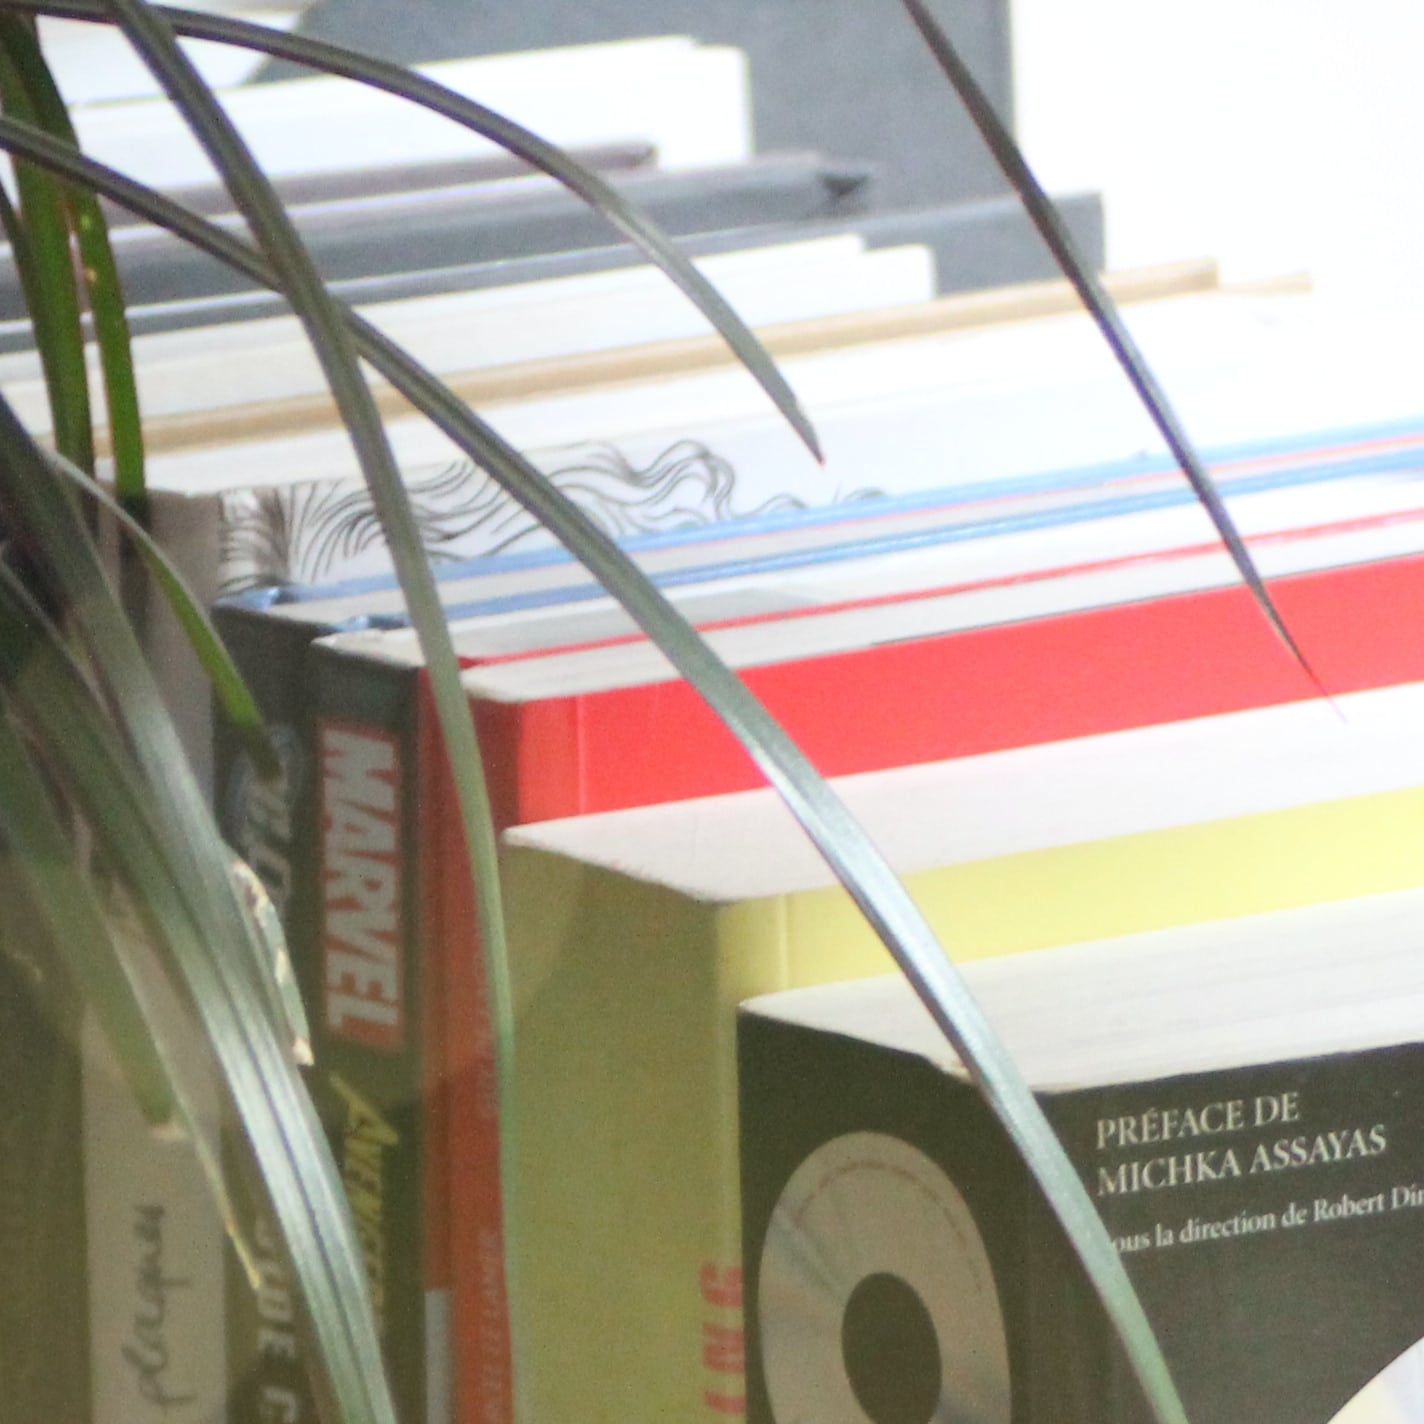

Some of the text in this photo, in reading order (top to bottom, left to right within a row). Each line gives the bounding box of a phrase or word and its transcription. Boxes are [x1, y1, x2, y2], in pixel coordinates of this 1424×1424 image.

[322, 730, 399, 1029] MARVEL
[1096, 1092, 1300, 1150] PRÉFACE DE
[1097, 1124, 1387, 1196] MICHKA ASSAYAS
[1109, 1227, 1151, 1253] ous
[1155, 1224, 1176, 1247] la
[1179, 1209, 1276, 1243] direction
[1281, 1203, 1308, 1229] de
[1313, 1192, 1384, 1223] Robert
